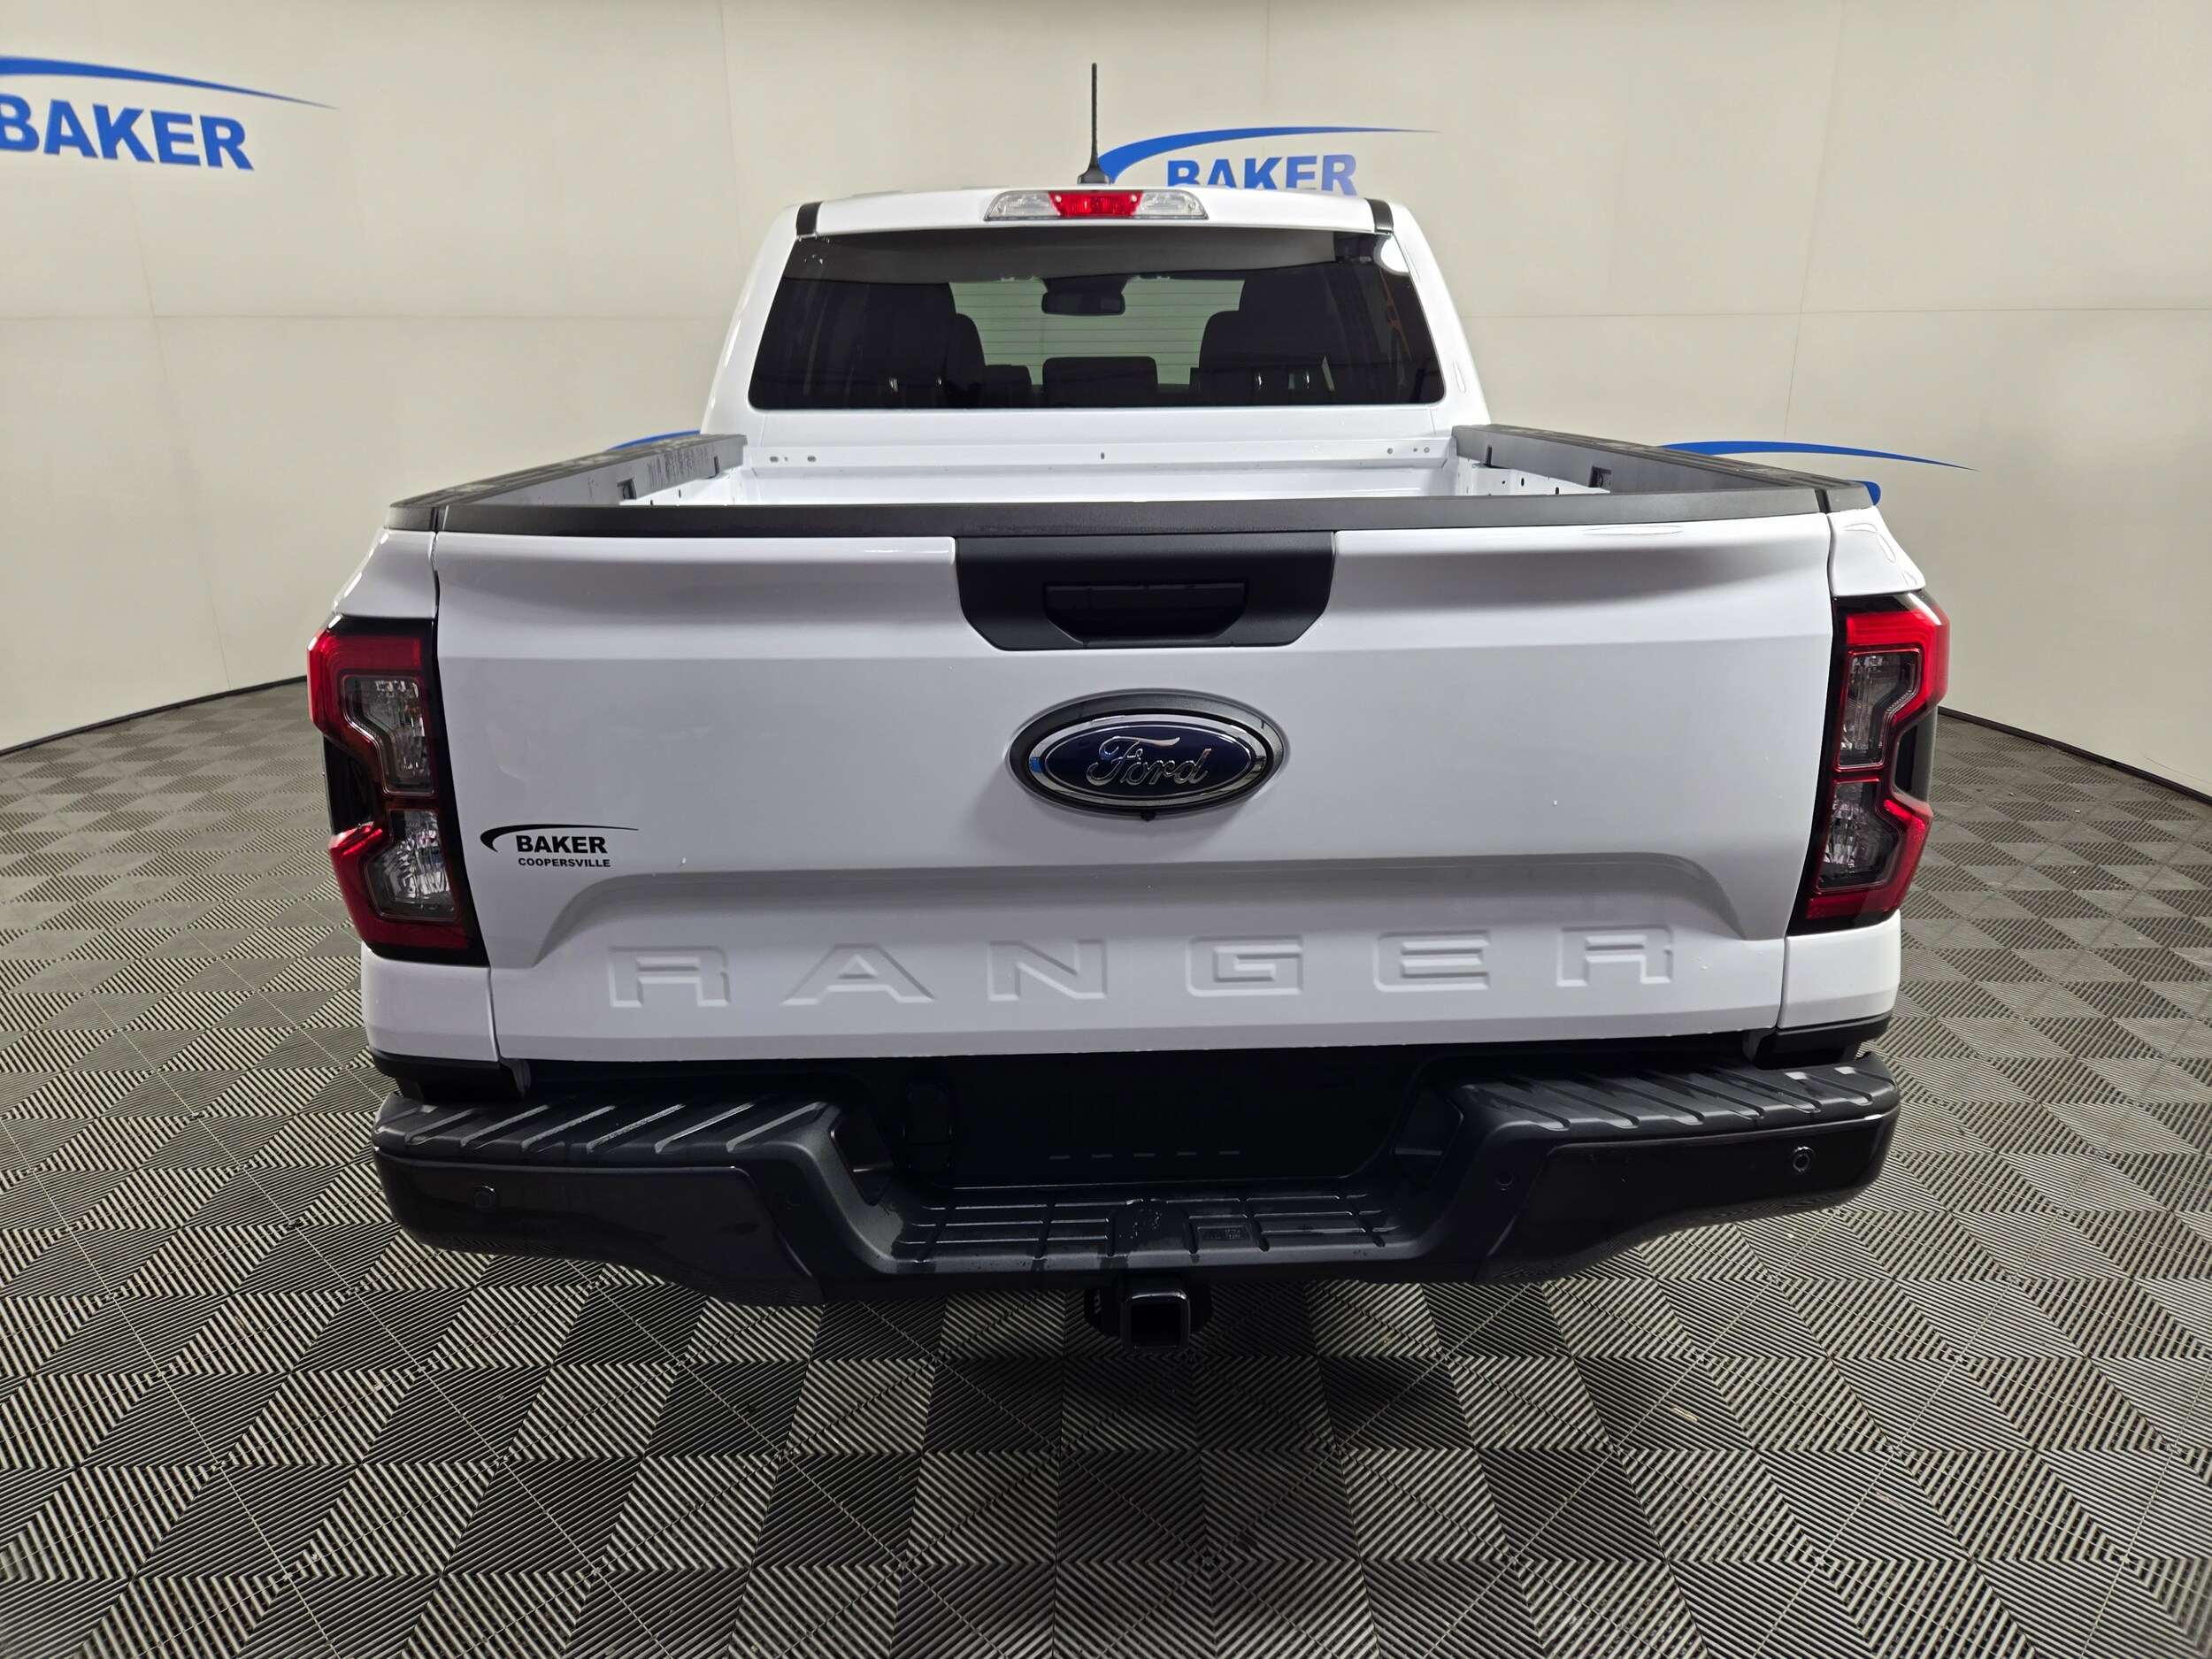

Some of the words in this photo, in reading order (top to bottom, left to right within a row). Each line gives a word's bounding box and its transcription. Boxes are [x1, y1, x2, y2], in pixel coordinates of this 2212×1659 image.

[0, 93, 255, 171] BAKER
[1167, 154, 1357, 196] BAKER
[1086, 735, 1212, 786] Ford
[516, 834, 608, 854] BAKER
[518, 857, 611, 868] COOPERSVILLE
[608, 924, 1675, 1009] RANGER
